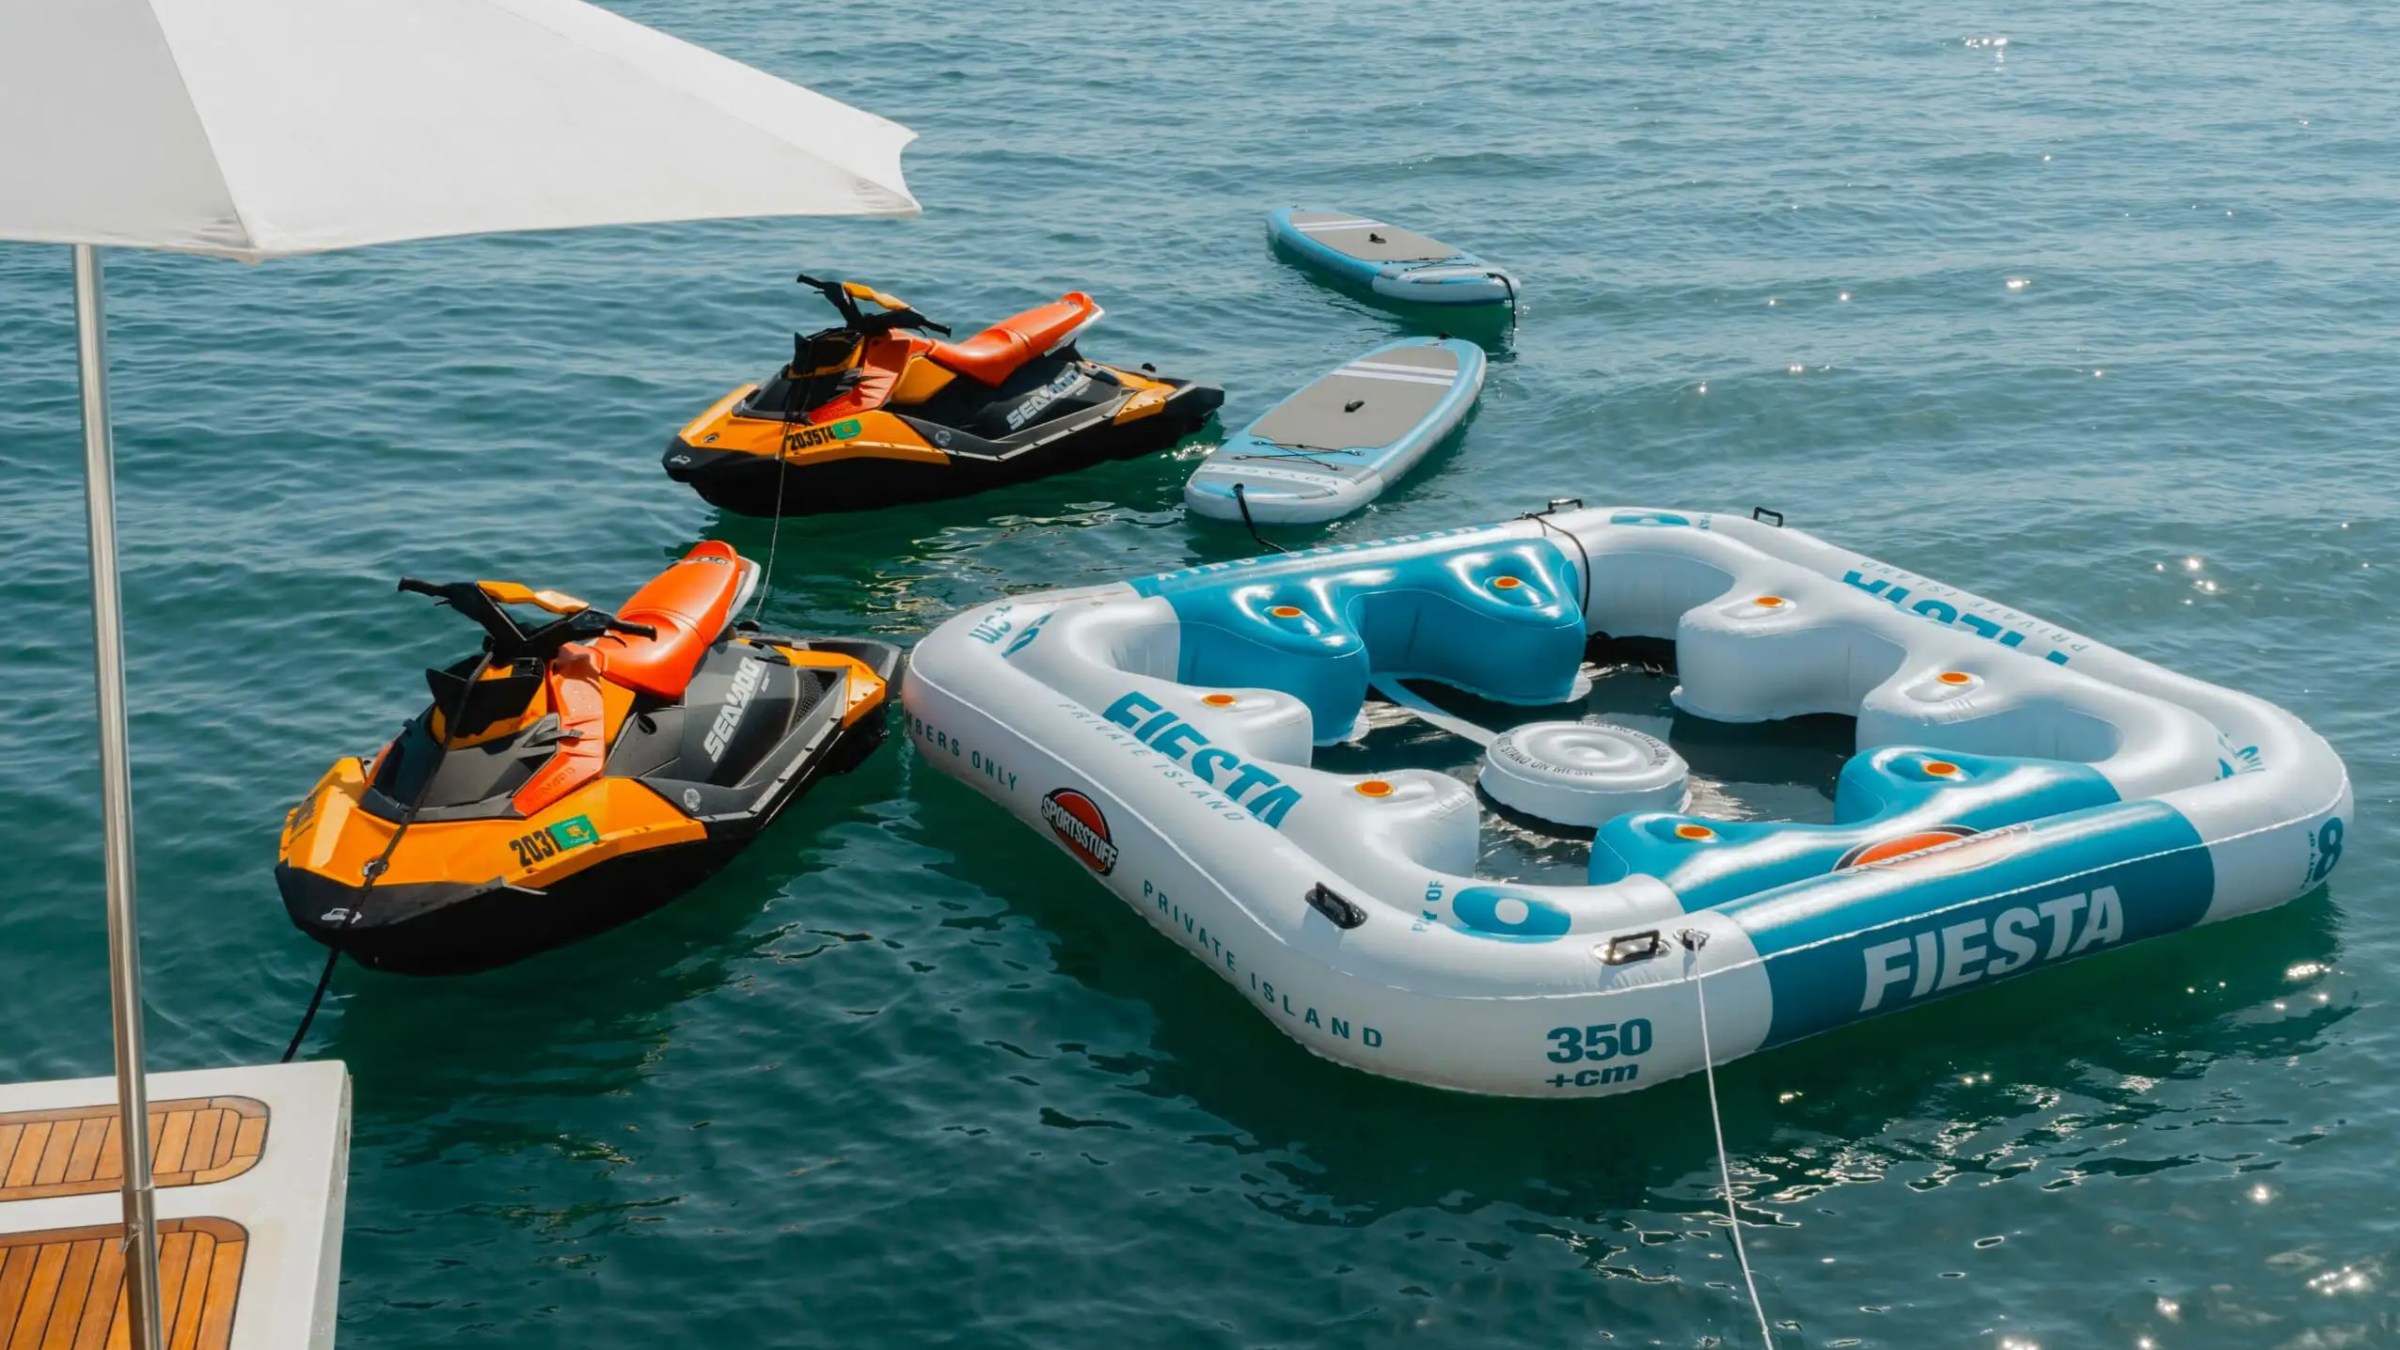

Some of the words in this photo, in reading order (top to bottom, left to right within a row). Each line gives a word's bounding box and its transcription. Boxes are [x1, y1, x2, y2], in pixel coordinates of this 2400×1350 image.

[972, 750, 1018, 791] ONLY
[1058, 704, 1150, 757] PRIVATE
[1153, 762, 1245, 823] ISLAND
[1042, 796, 1118, 868] SPORTSSTUFF
[1143, 880, 1236, 973] PRIVATE
[1251, 972, 1383, 1048] ISLAND
[1859, 885, 2124, 1013] FIESTA
[1545, 1063, 1639, 1088] +cm
[1546, 1018, 1653, 1064] 350
